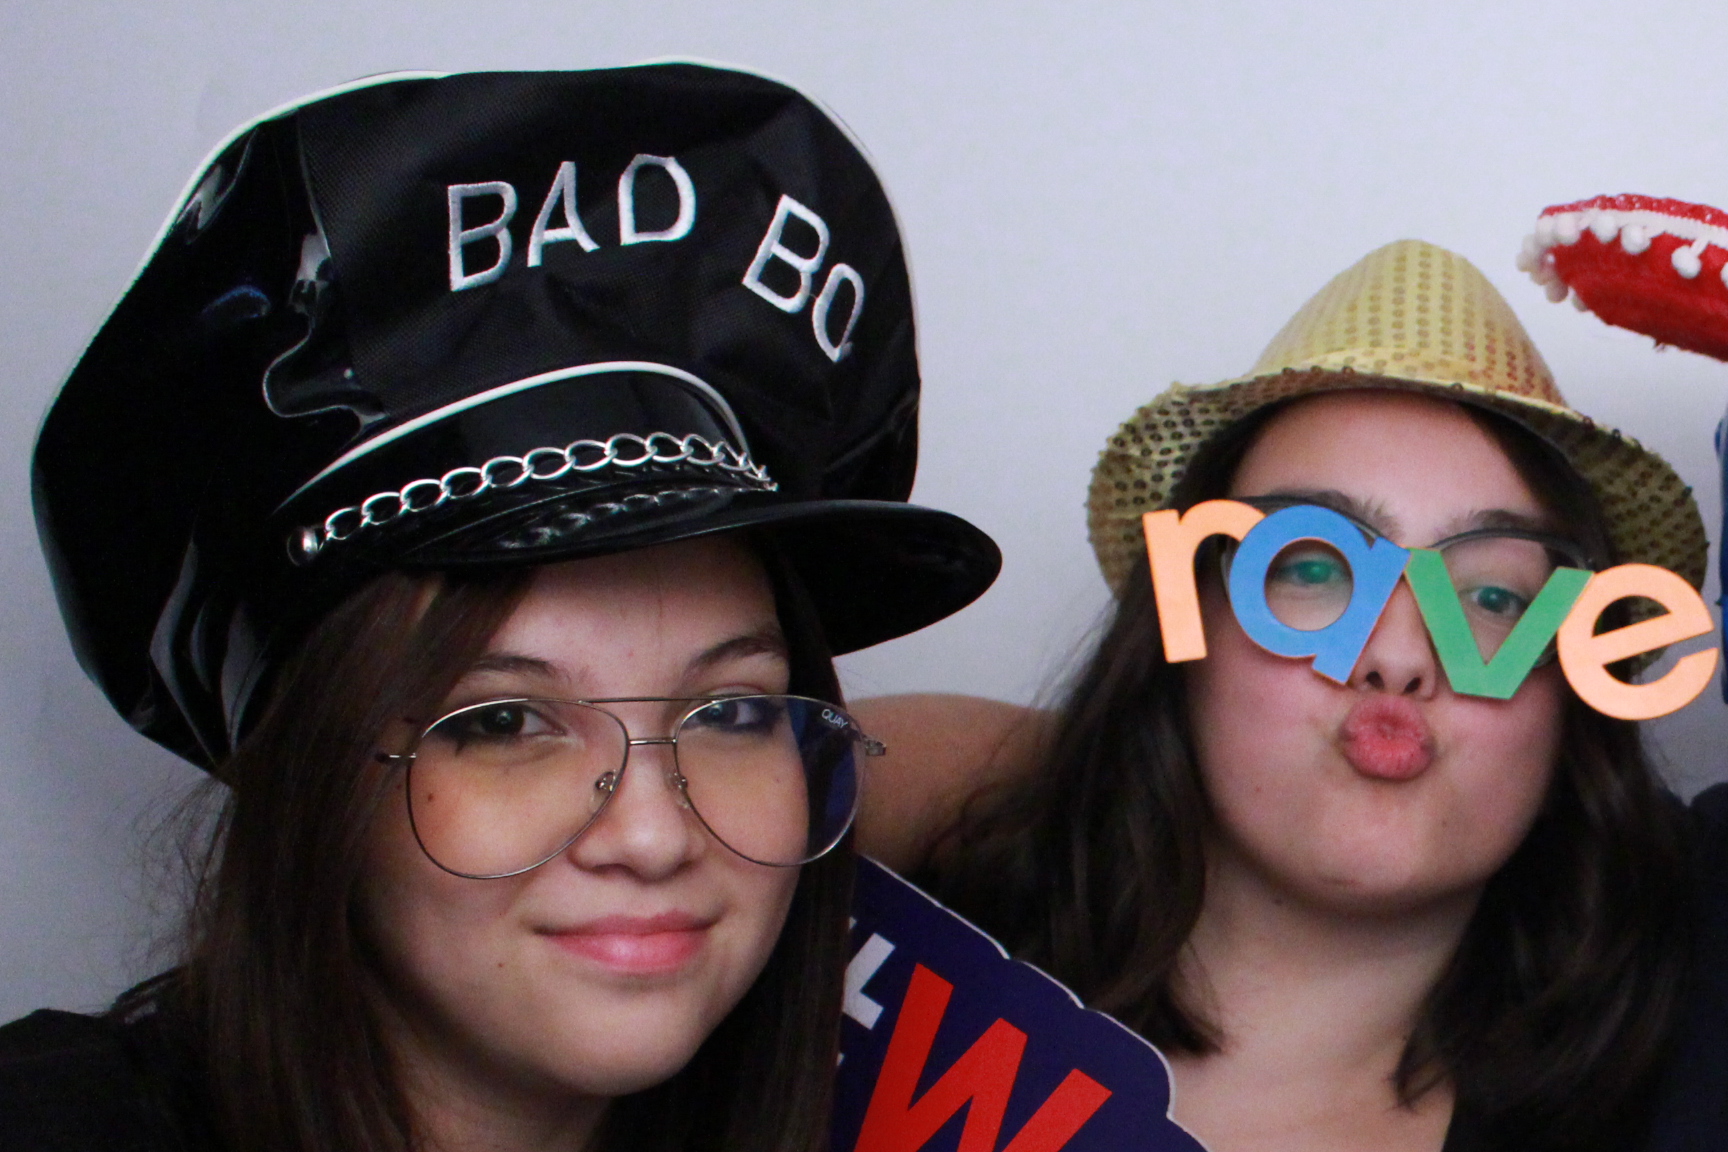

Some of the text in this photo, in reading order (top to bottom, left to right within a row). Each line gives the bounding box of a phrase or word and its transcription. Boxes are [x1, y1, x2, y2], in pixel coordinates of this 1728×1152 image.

[447, 152, 697, 292] BAD
[1142, 499, 1719, 720] rave
[821, 707, 849, 730] QUAY
